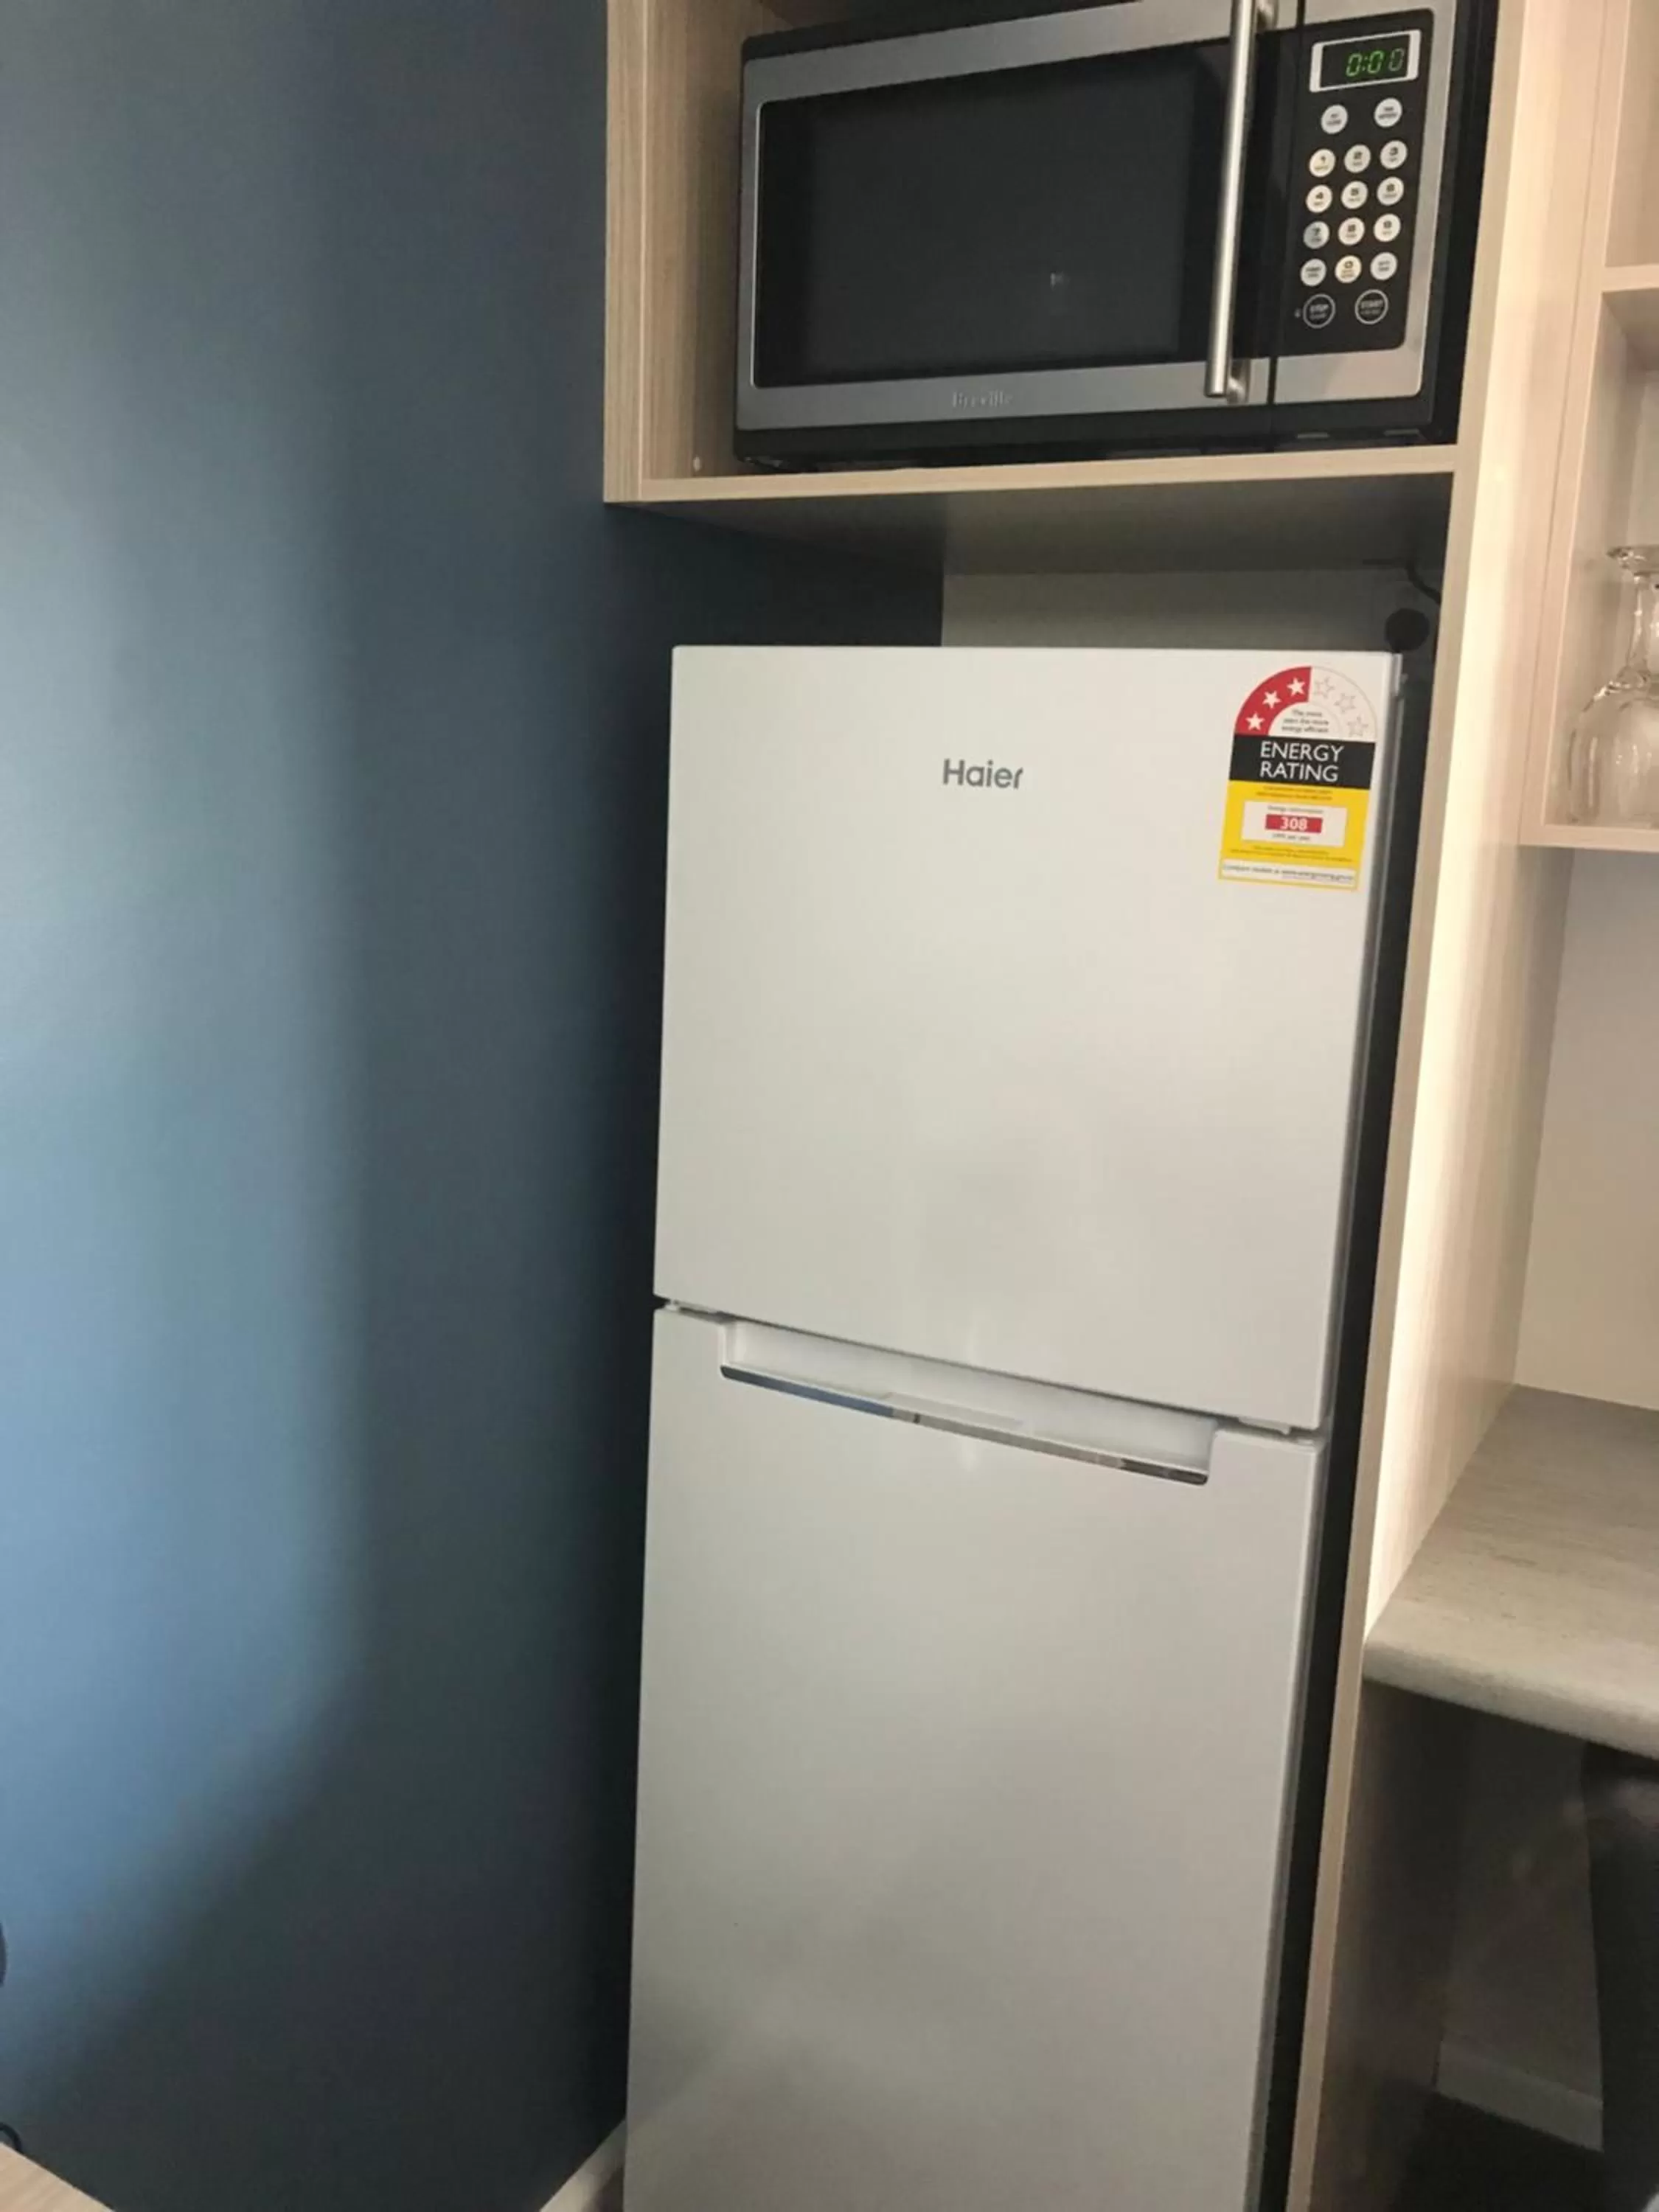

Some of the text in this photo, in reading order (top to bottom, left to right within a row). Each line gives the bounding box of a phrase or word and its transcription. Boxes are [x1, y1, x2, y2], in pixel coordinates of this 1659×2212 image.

[1259, 740, 1345, 763] ENERGY
[942, 757, 1024, 790] Haier
[1259, 760, 1340, 783] RATING
